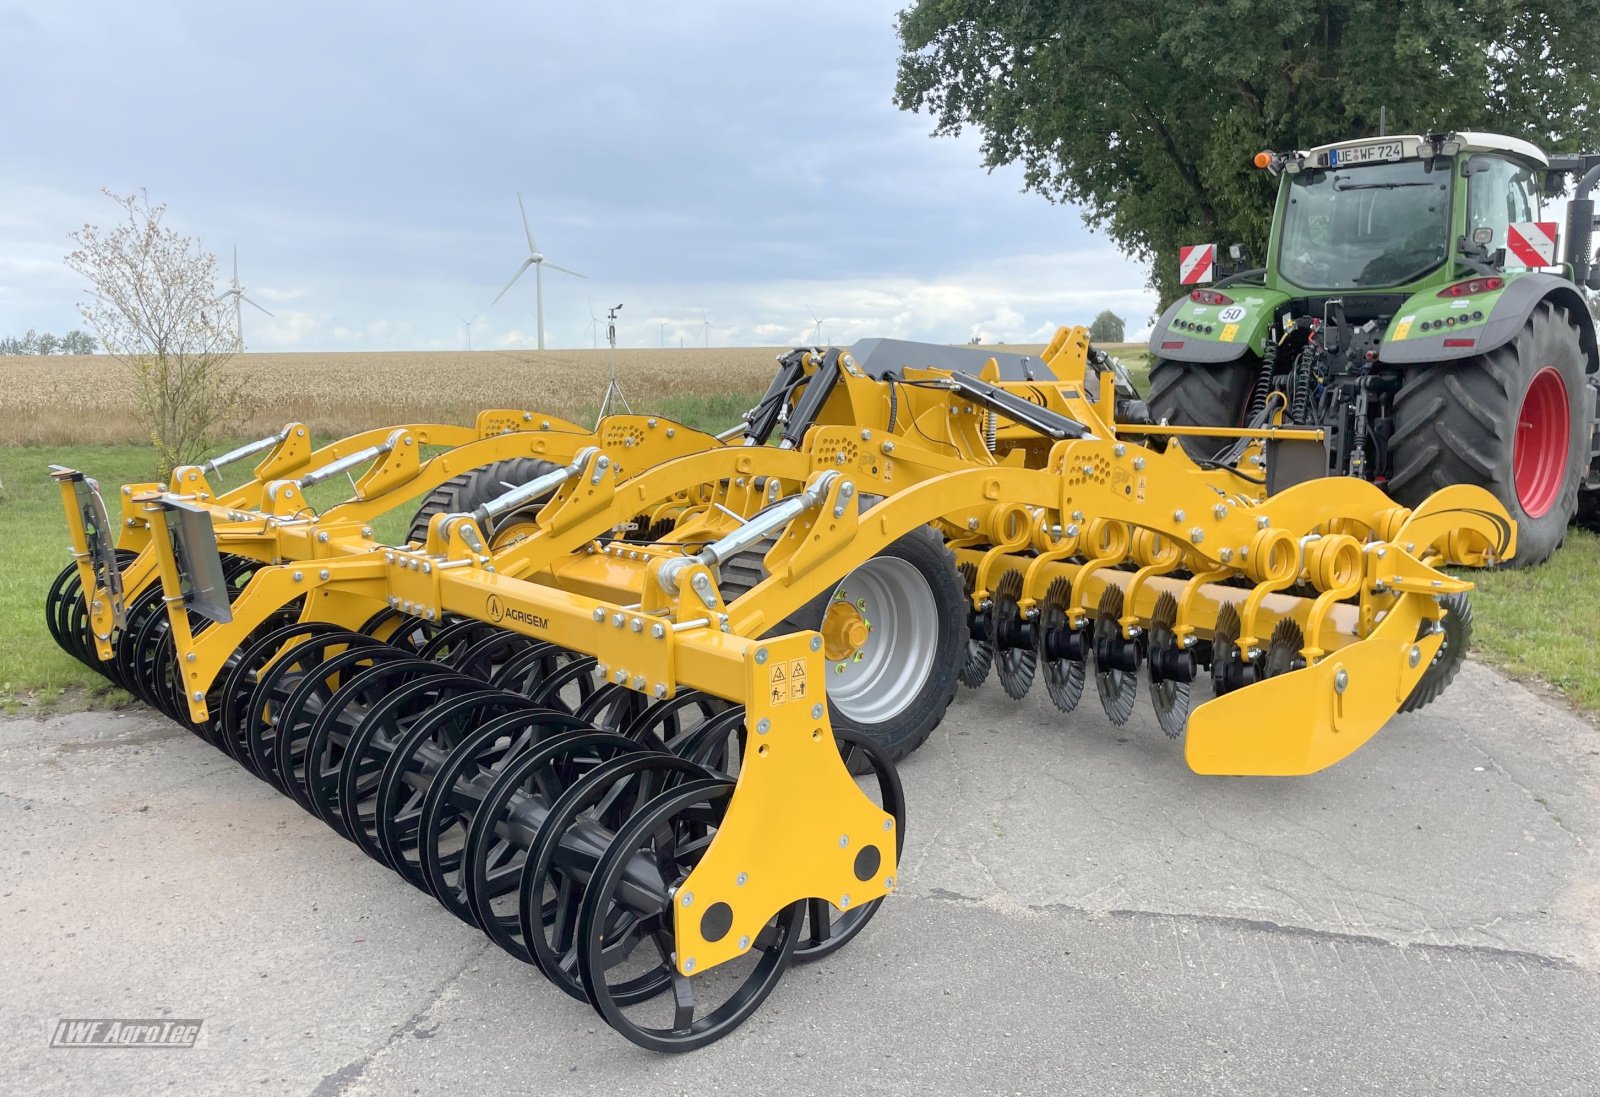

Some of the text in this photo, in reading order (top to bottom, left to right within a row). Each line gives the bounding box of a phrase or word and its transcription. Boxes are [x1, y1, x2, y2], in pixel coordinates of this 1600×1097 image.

[1338, 150, 1352, 162] UE
[1360, 147, 1375, 160] WF
[1378, 144, 1400, 158] 724
[1223, 308, 1242, 320] 50
[505, 607, 549, 630] AGRISEM
